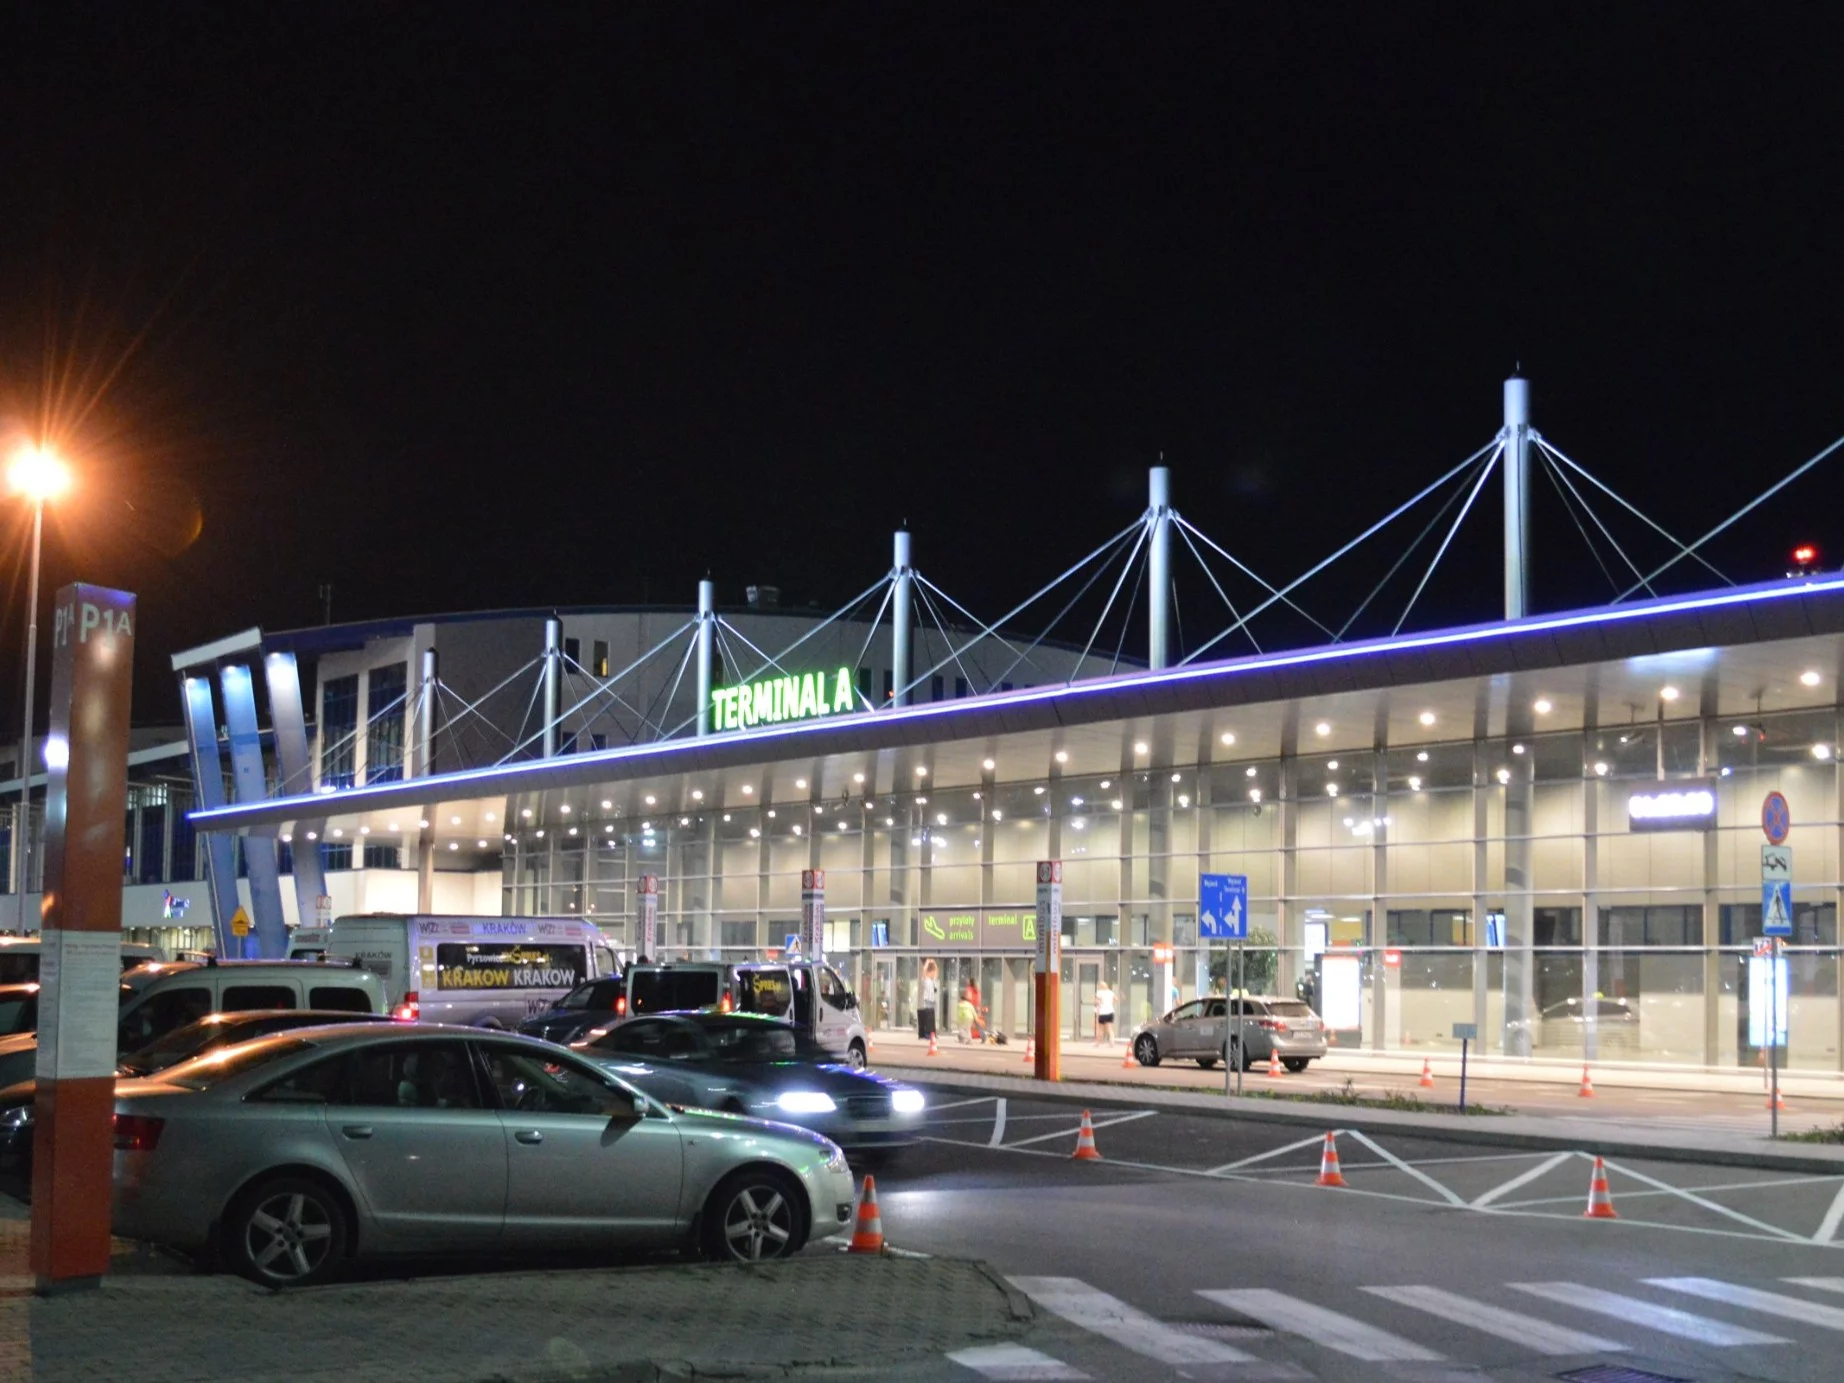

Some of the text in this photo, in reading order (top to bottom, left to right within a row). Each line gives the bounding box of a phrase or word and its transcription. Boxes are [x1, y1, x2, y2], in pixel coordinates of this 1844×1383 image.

[80, 602, 132, 649] P1A
[711, 666, 854, 731] TERMINAL A
[482, 921, 527, 935] KRAKÓW
[988, 914, 1017, 926] terminal
[949, 930, 974, 940] arrivals
[514, 968, 575, 986] KRAKOW
